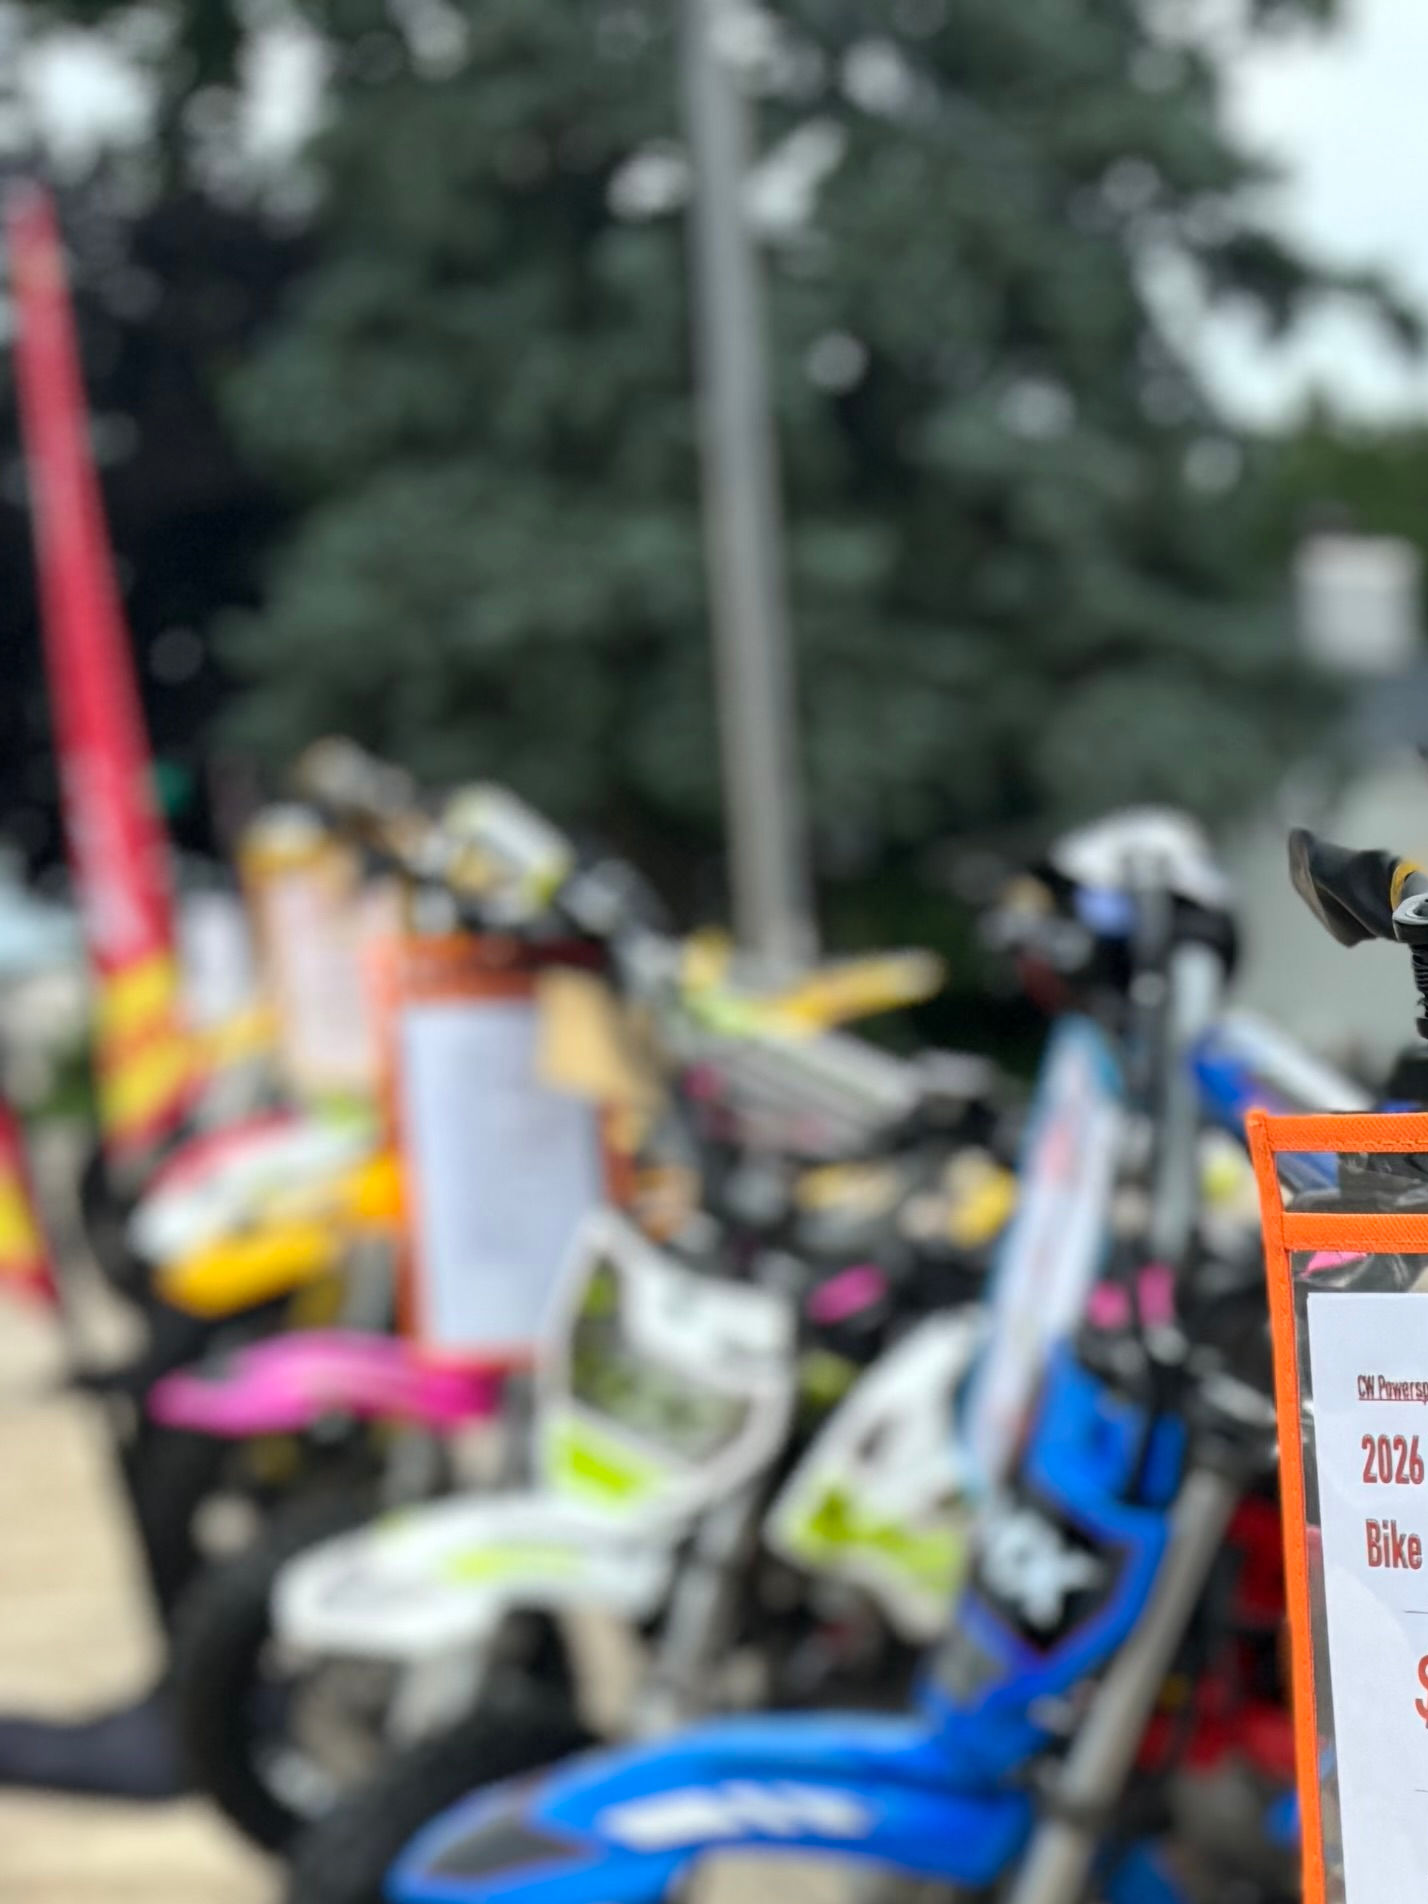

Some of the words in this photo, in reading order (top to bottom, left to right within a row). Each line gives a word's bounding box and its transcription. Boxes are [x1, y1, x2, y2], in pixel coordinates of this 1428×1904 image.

[1357, 1375, 1375, 1399] CW
[1361, 1434, 1425, 1485] 2026
[1365, 1518, 1423, 1570] Bike
